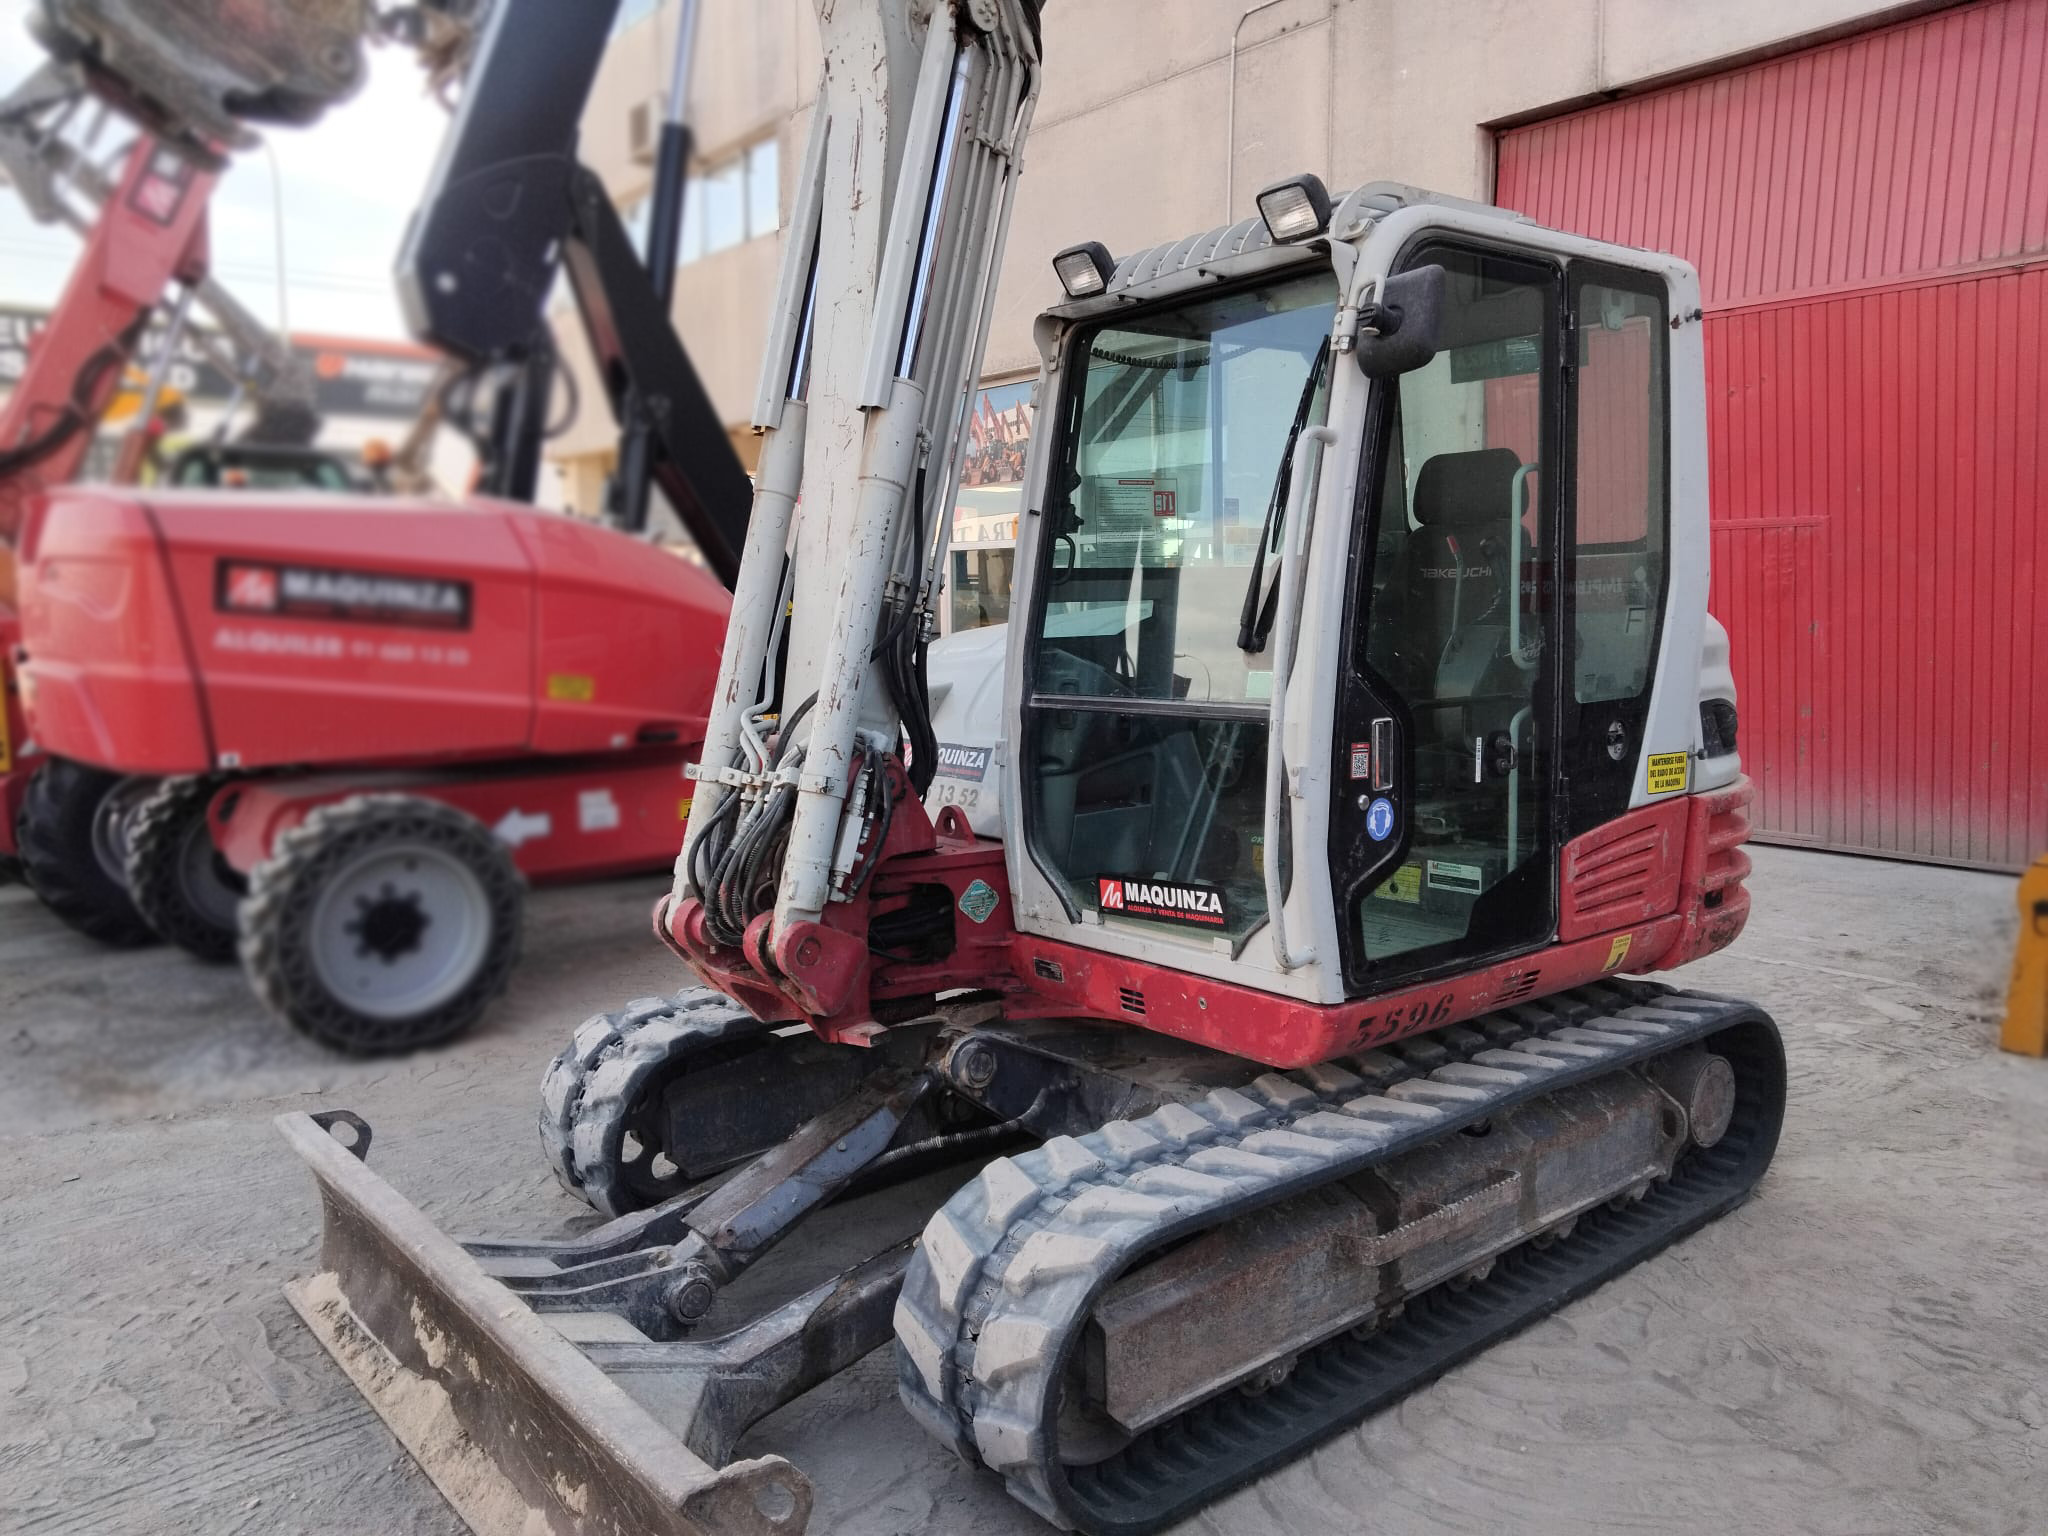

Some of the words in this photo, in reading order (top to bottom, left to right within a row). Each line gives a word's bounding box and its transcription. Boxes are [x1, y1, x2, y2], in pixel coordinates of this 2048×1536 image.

[938, 747, 985, 769] QUINZA
[937, 784, 955, 803] 13
[958, 787, 979, 808] 52
[1124, 881, 1223, 914] MAQUINZA
[1158, 909, 1176, 918] VENTA
[1177, 911, 1184, 919] DE
[1185, 912, 1224, 925] MAQUINARIA
